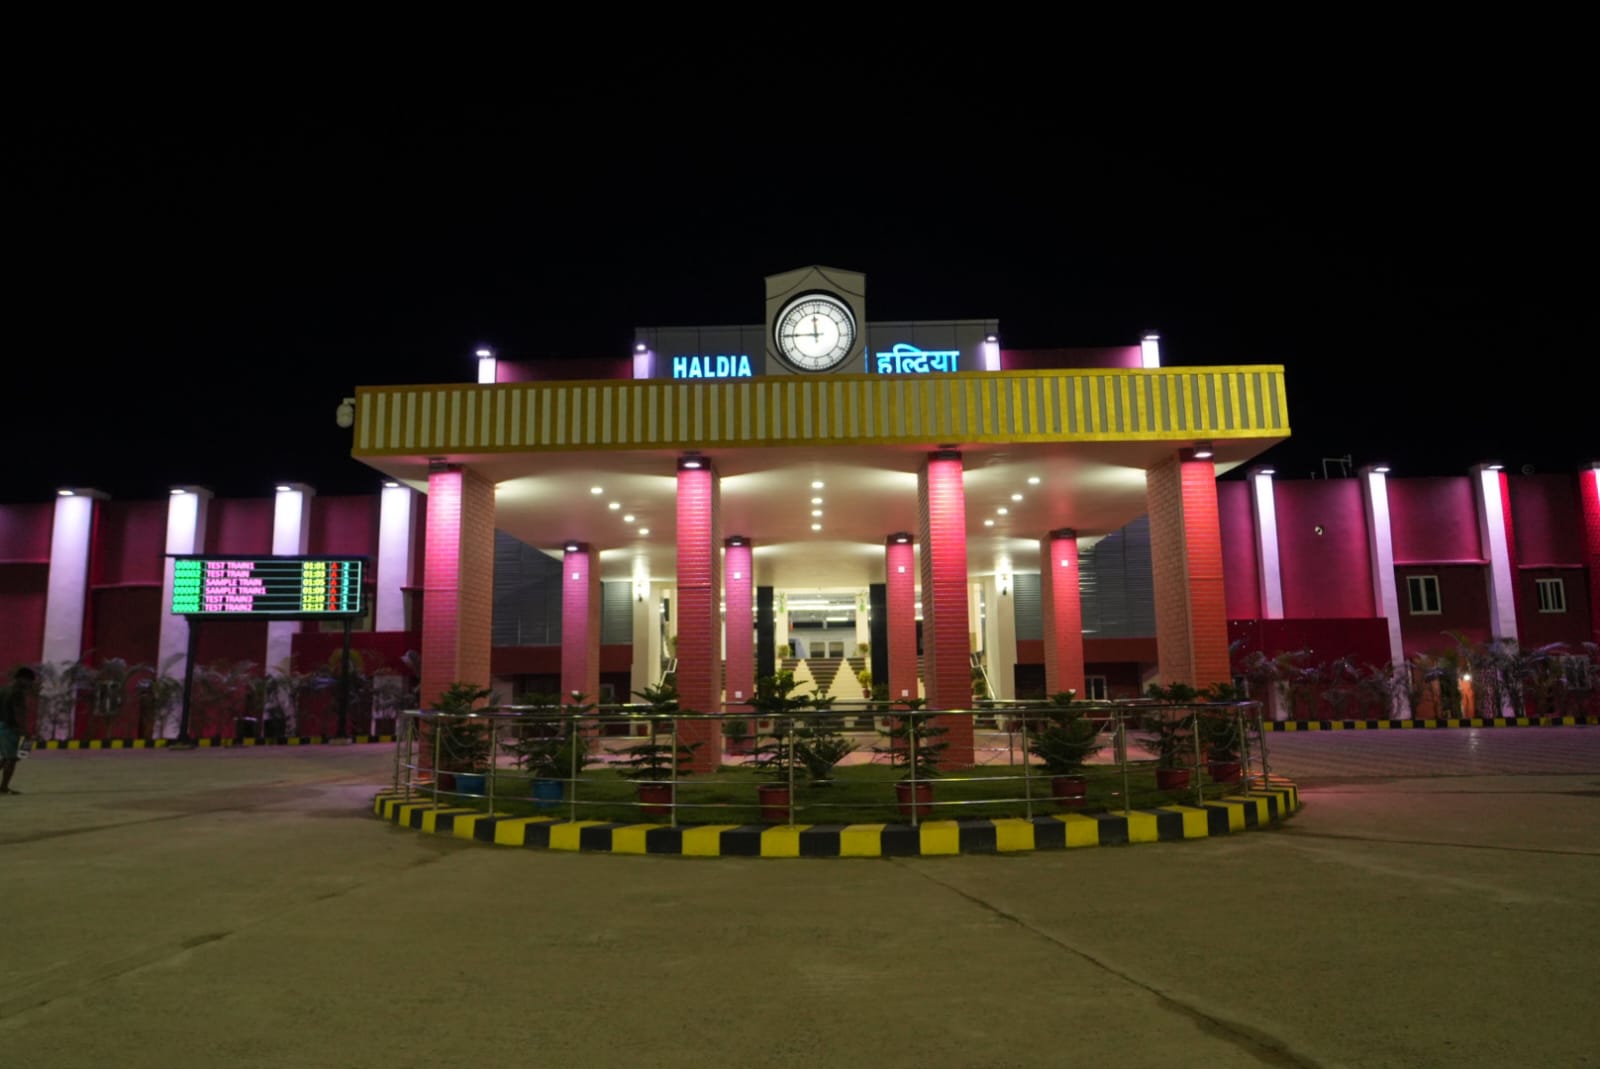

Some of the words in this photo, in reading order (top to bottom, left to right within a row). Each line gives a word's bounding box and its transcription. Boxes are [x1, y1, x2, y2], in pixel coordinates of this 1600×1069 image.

[673, 355, 752, 378] HALDIA
[876, 343, 960, 374] हल्दिया
[207, 570, 224, 578] TEST
[227, 570, 250, 578] TRAIN
